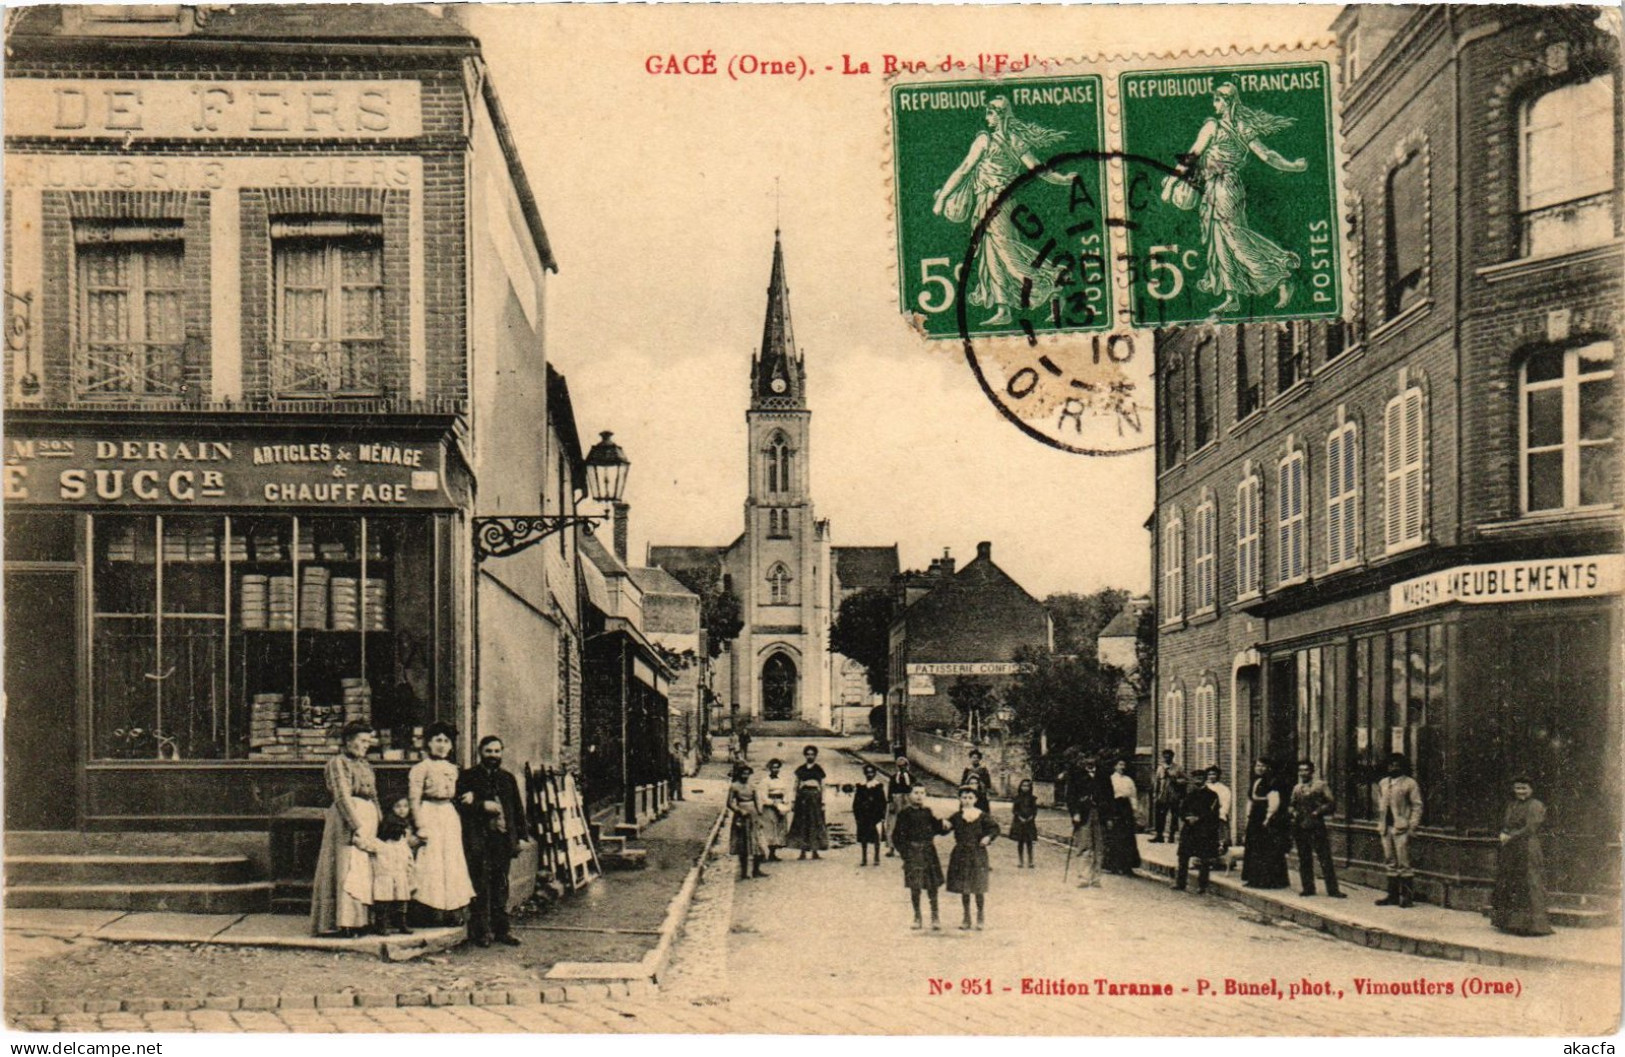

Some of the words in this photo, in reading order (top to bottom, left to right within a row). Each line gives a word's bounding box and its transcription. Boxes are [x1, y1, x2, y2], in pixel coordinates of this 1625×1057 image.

[1240, 71, 1321, 93] FRANÇAISE
[1012, 85, 1094, 106] FRANÇAISE
[54, 88, 144, 131] DE
[191, 88, 394, 132] FERS
[275, 160, 409, 188] ACIERS
[1308, 219, 1332, 303] POSTES
[96, 441, 233, 461] DERAIN
[252, 443, 332, 465] ARTICLES
[359, 443, 424, 467] MÉNAGE
[332, 464, 348, 478] &
[264, 483, 408, 501] CHAUFFAGE
